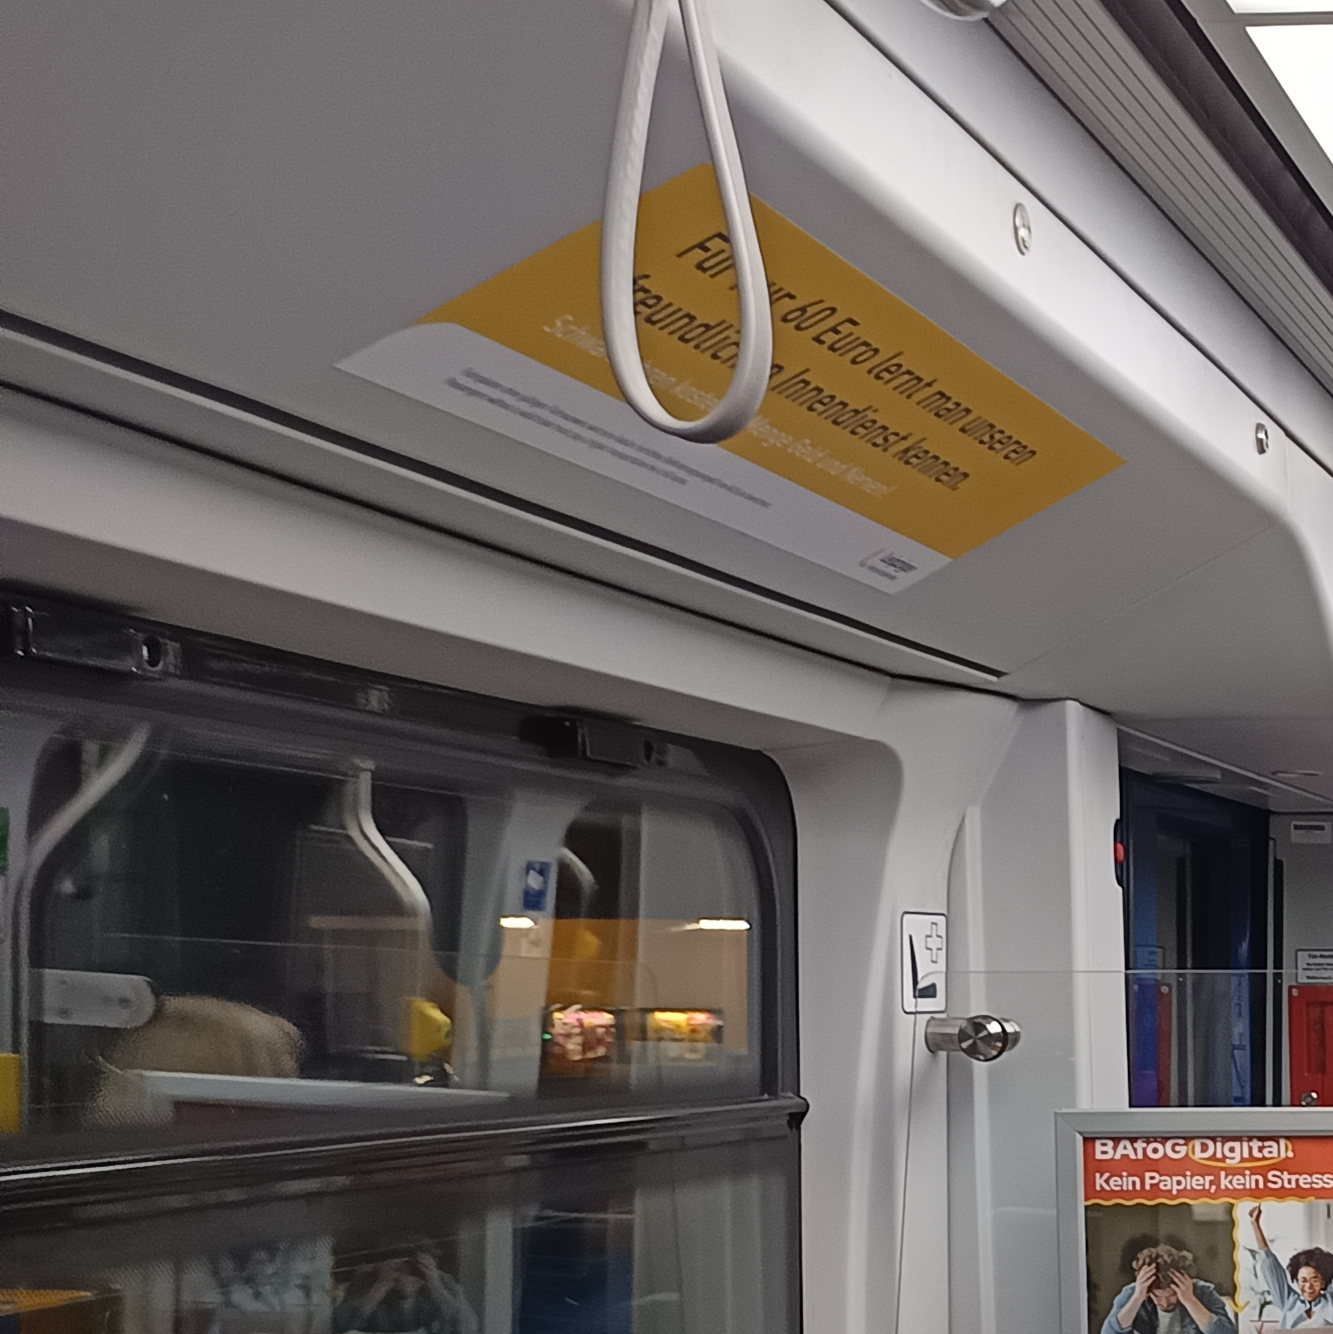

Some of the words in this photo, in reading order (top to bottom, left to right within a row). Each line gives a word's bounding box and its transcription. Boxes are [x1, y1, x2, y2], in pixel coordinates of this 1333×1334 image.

[770, 367, 913, 453] Innendienst
[781, 298, 838, 332] 60
[812, 316, 880, 366] Euro
[866, 350, 938, 400] lernt
[915, 390, 973, 426] man
[958, 415, 1037, 466] unseren
[1095, 1138, 1188, 1160] BAföG
[1193, 1138, 1294, 1165] Digital.
[1095, 1171, 1141, 1191] Kein
[1145, 1171, 1217, 1195] Papier,
[1220, 1170, 1264, 1190] kein
